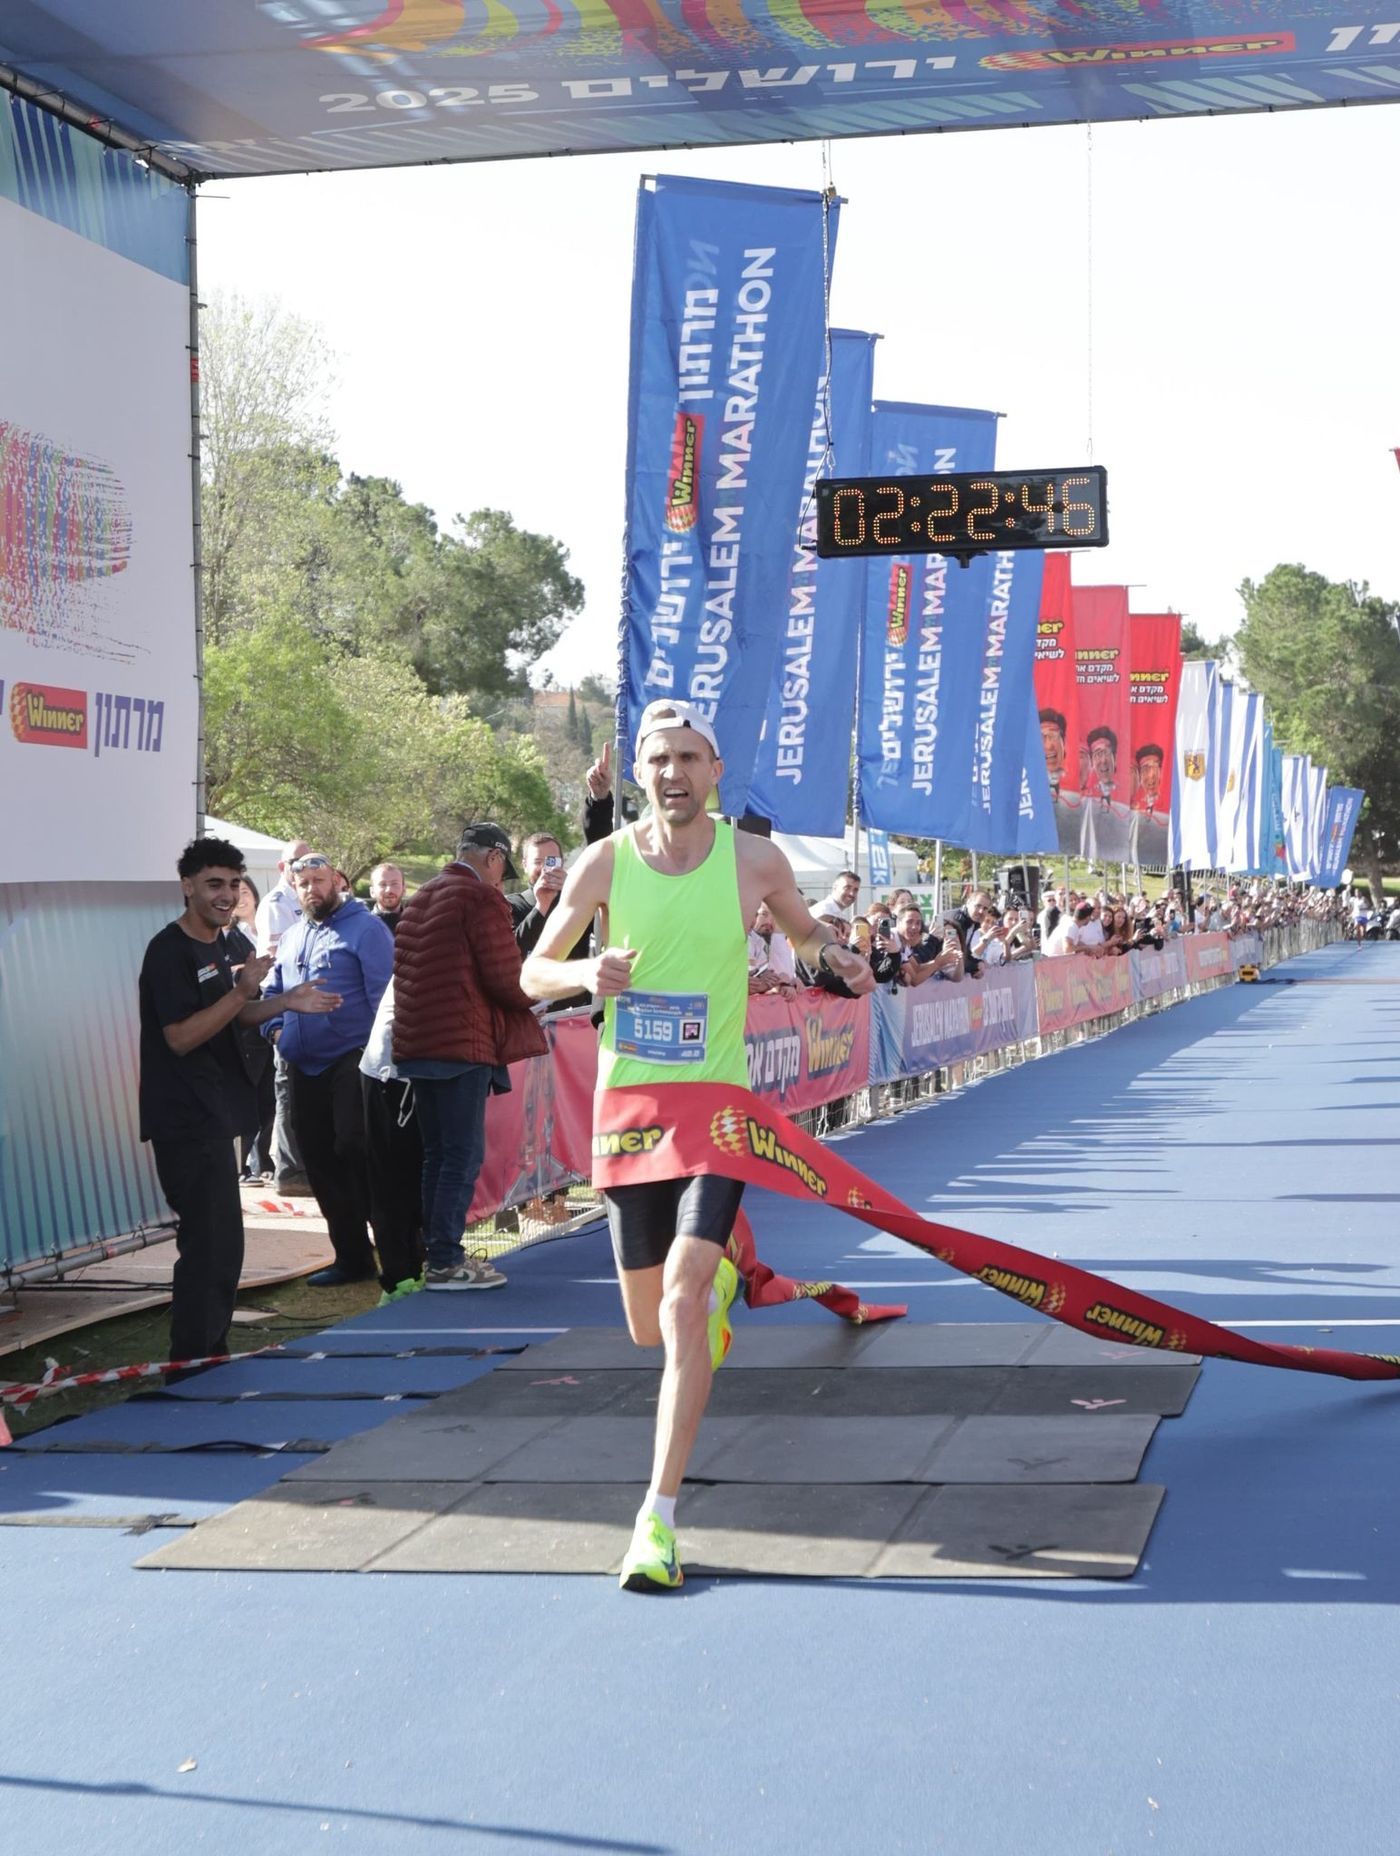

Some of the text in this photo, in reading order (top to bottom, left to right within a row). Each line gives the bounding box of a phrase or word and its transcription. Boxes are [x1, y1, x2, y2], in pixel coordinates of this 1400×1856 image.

[561, 56, 957, 98] ירושלים
[1045, 38, 1283, 64] Winner
[318, 83, 540, 112] 2025
[678, 288, 719, 404] מרתון
[671, 419, 696, 506] Winner
[690, 247, 776, 726] ERUSALEM MARATHON
[833, 476, 1096, 546] 02:22:46
[891, 568, 908, 628] Winner
[1036, 638, 1057, 649] מקד
[775, 585, 817, 786] JERUSALEM
[911, 626, 944, 796] JERUSALEM
[980, 550, 1016, 815] JERUSALEM MARATH
[27, 692, 165, 758] Winner מרתון
[633, 1017, 673, 1042] 5159
[806, 1016, 854, 1074] Winner
[748, 1120, 828, 1196] Winner
[1086, 1303, 1165, 1347] Winner
